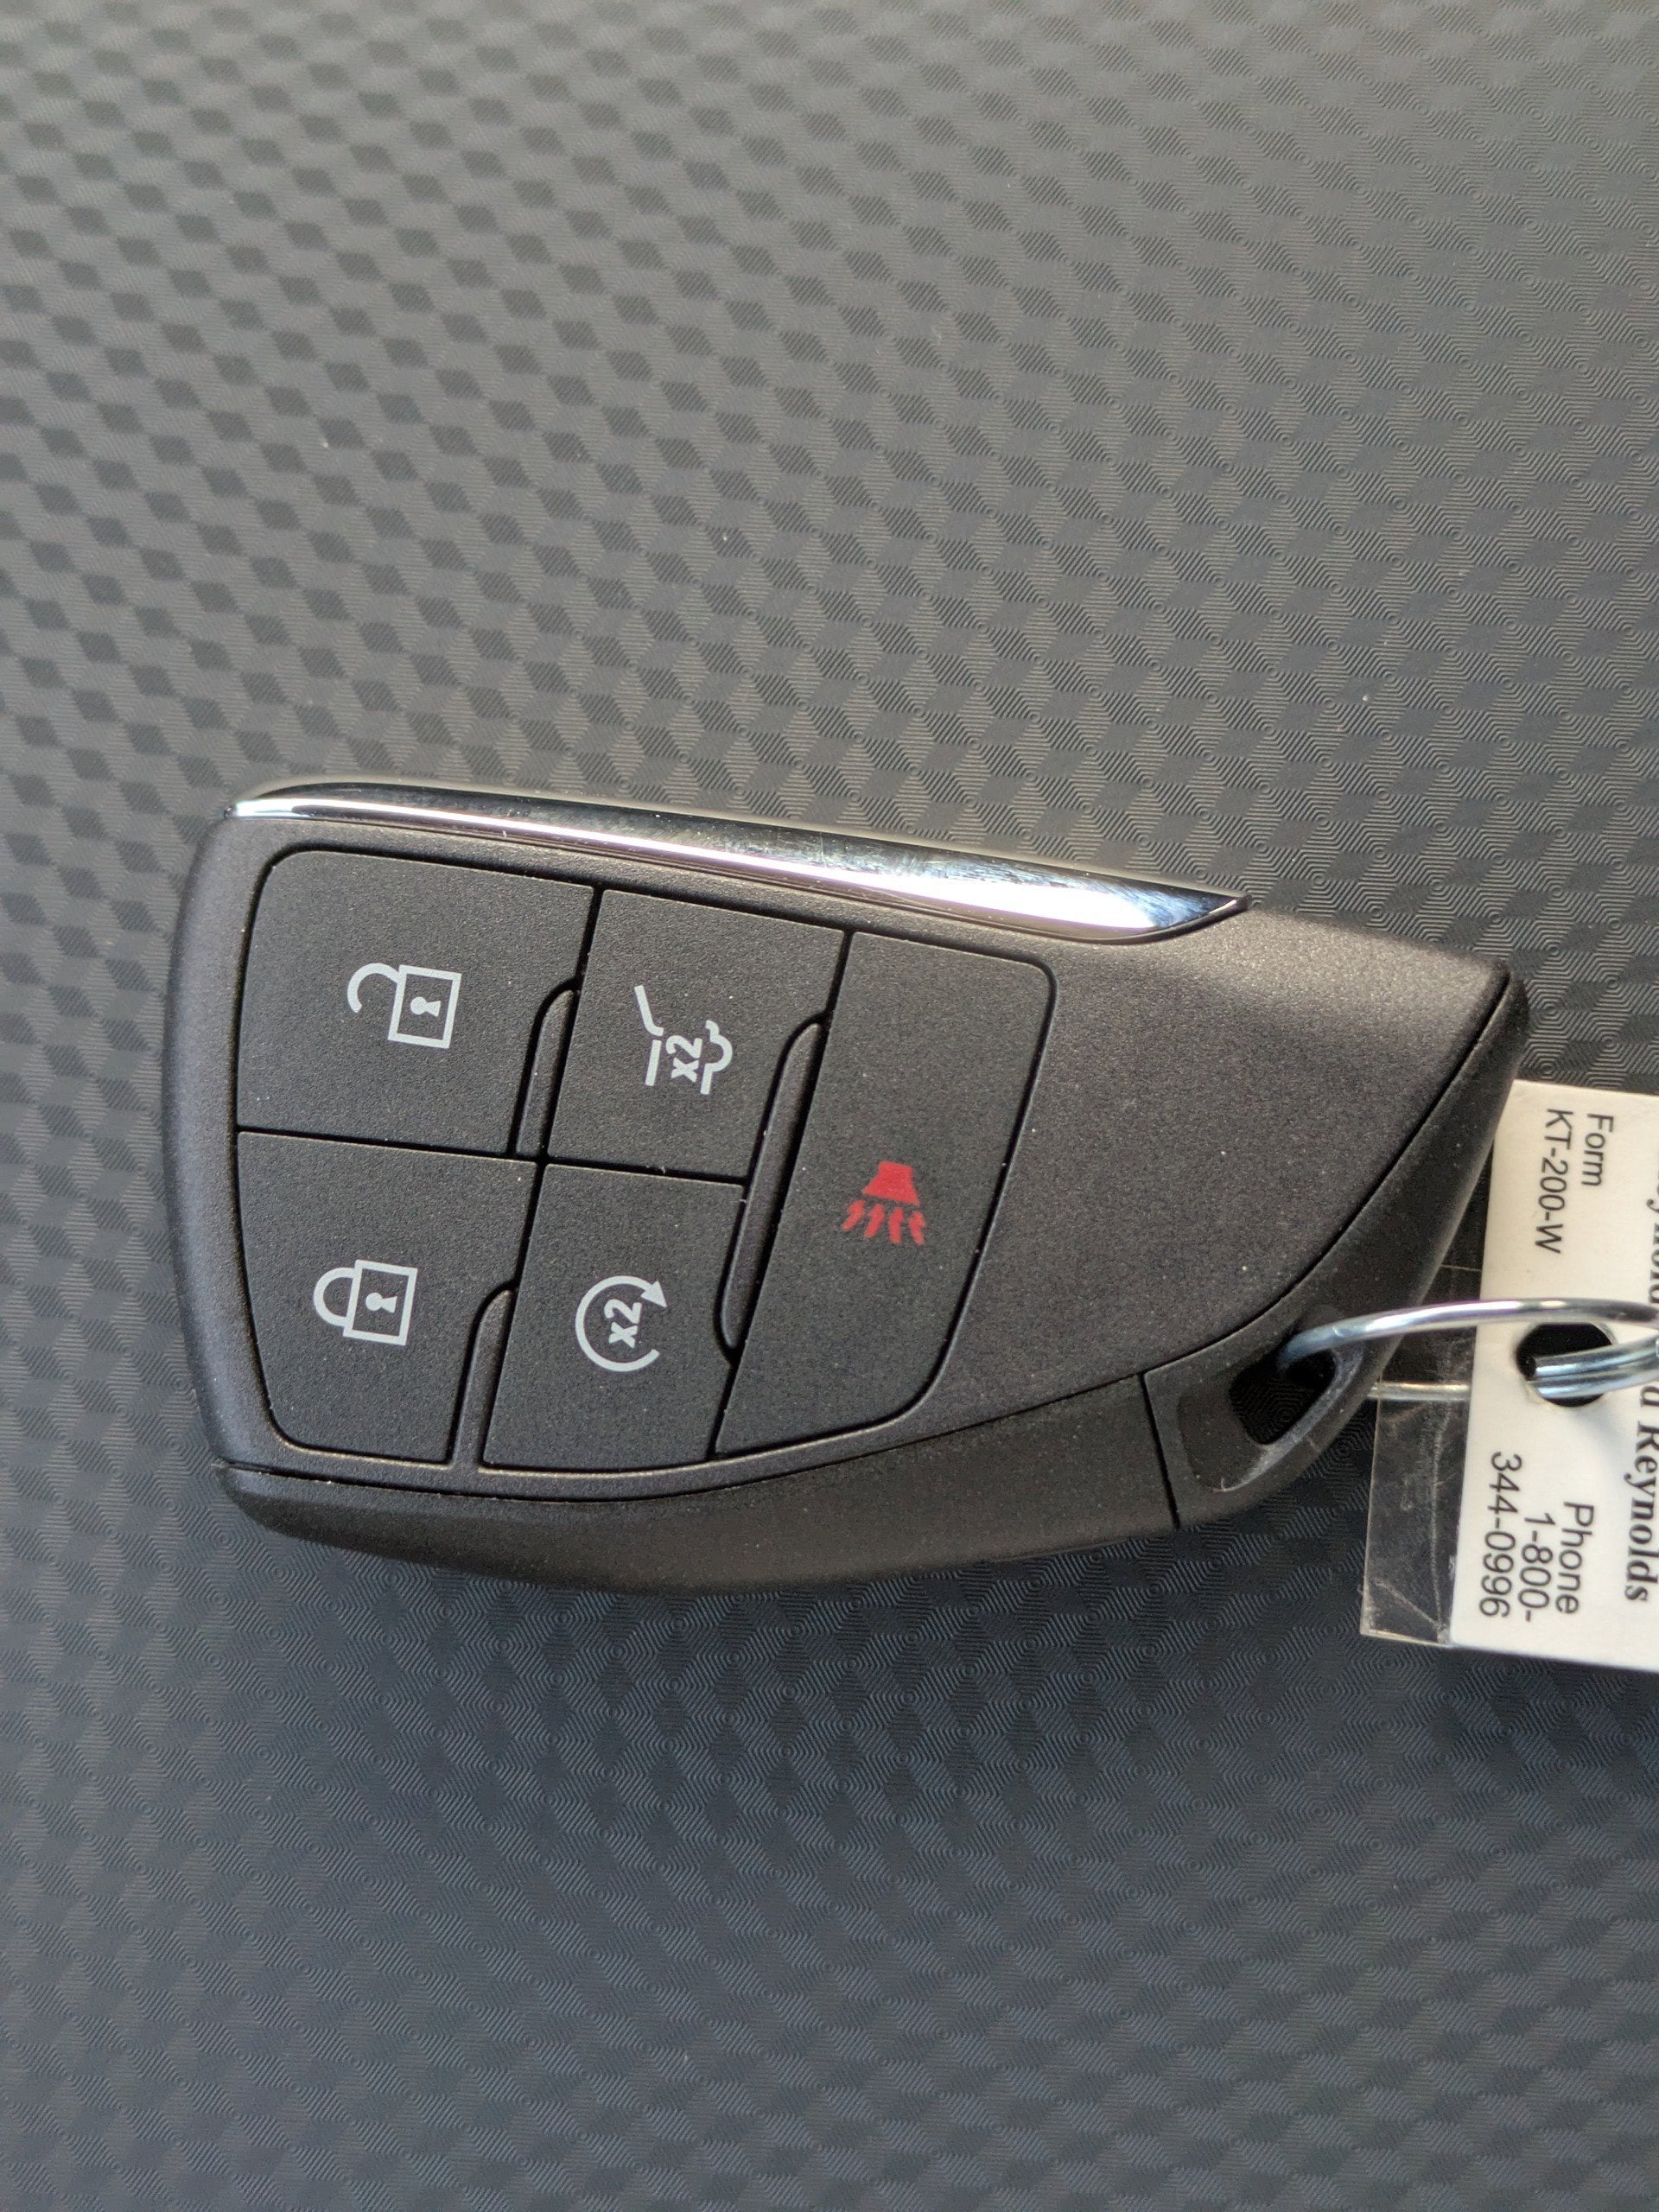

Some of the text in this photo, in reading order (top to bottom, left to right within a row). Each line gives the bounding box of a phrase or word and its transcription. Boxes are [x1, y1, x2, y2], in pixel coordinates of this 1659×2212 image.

[665, 1035, 702, 1083] x2
[1535, 1108, 1574, 1255] KT-200-W
[1581, 1113, 1614, 1187] Form
[604, 1298, 642, 1348] x2
[1478, 1451, 1522, 1618] 344-0996
[1517, 1512, 1556, 1623] 1-800-
[1554, 1501, 1595, 1615] Phone
[1624, 1421, 1659, 1602] Reynolds
